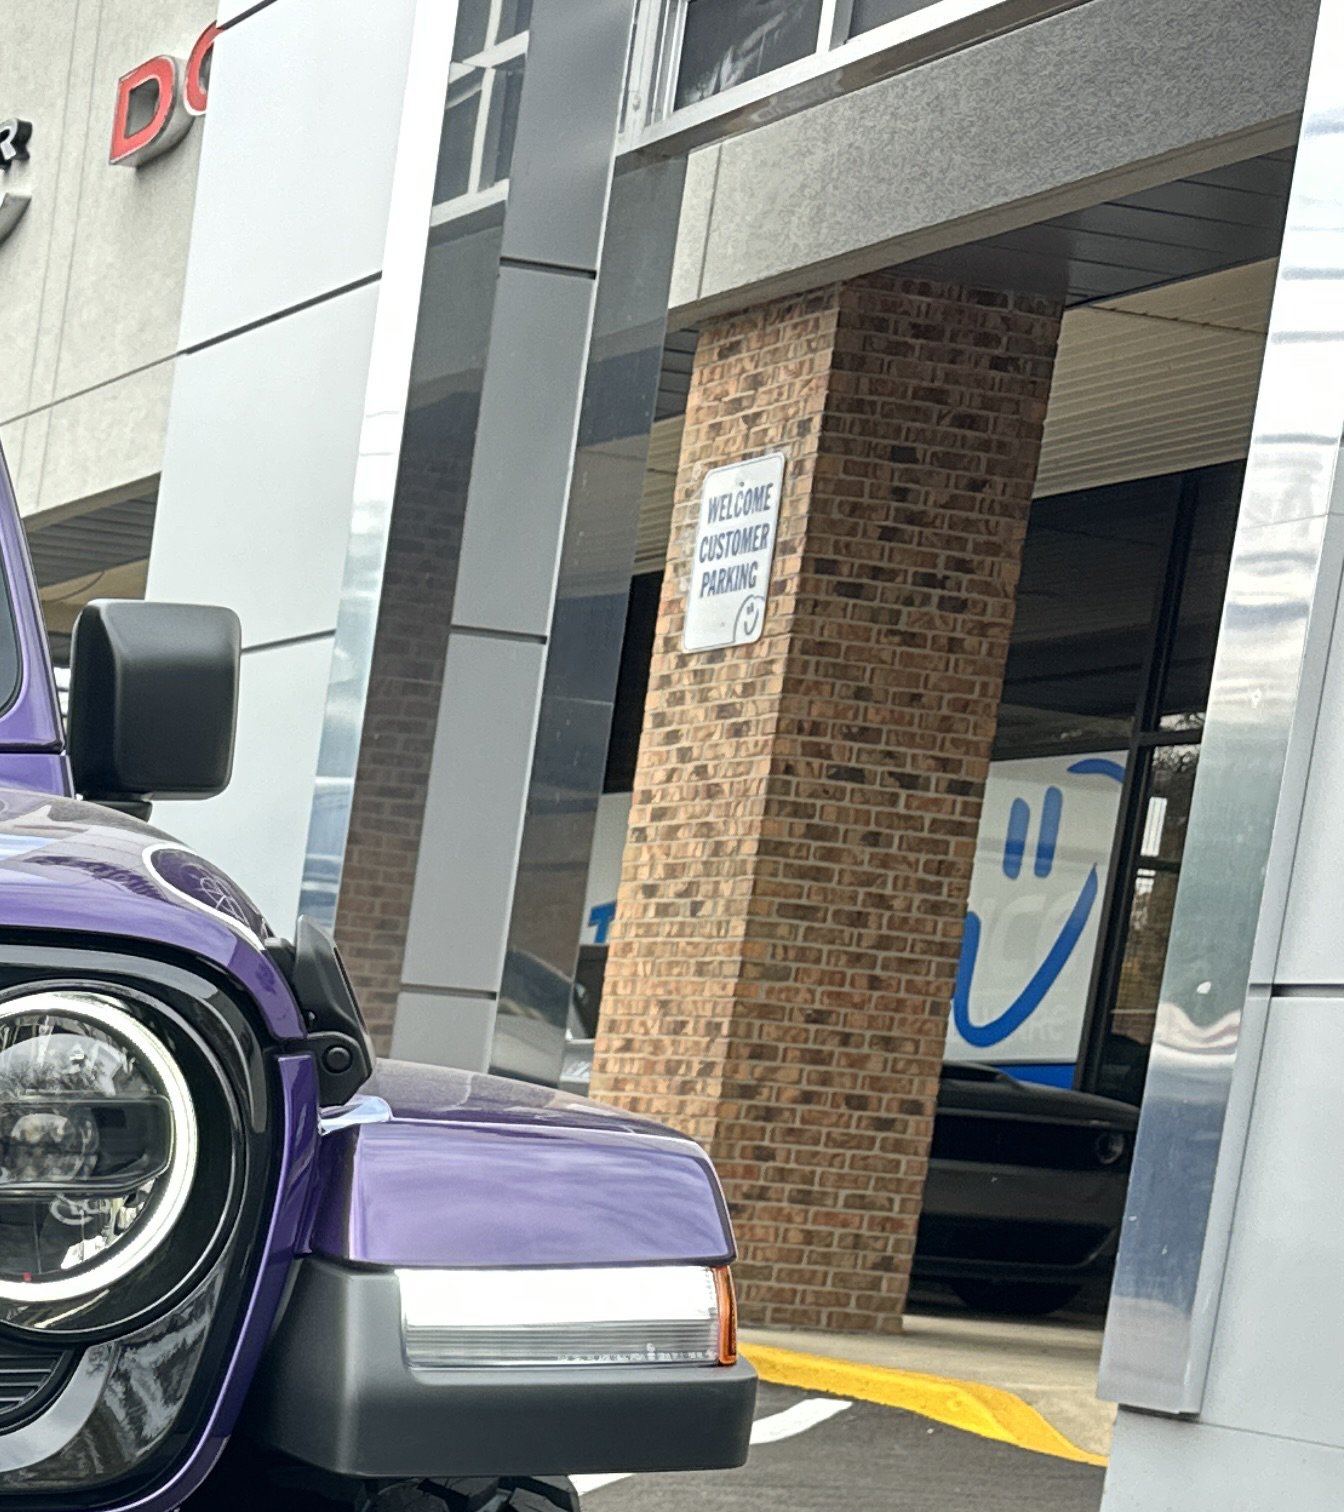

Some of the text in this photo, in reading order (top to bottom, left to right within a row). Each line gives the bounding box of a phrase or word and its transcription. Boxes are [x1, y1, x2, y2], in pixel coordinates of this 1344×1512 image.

[707, 482, 775, 524] WELCOME
[698, 522, 772, 564] CUSTOMER
[699, 560, 759, 599] PARKING
